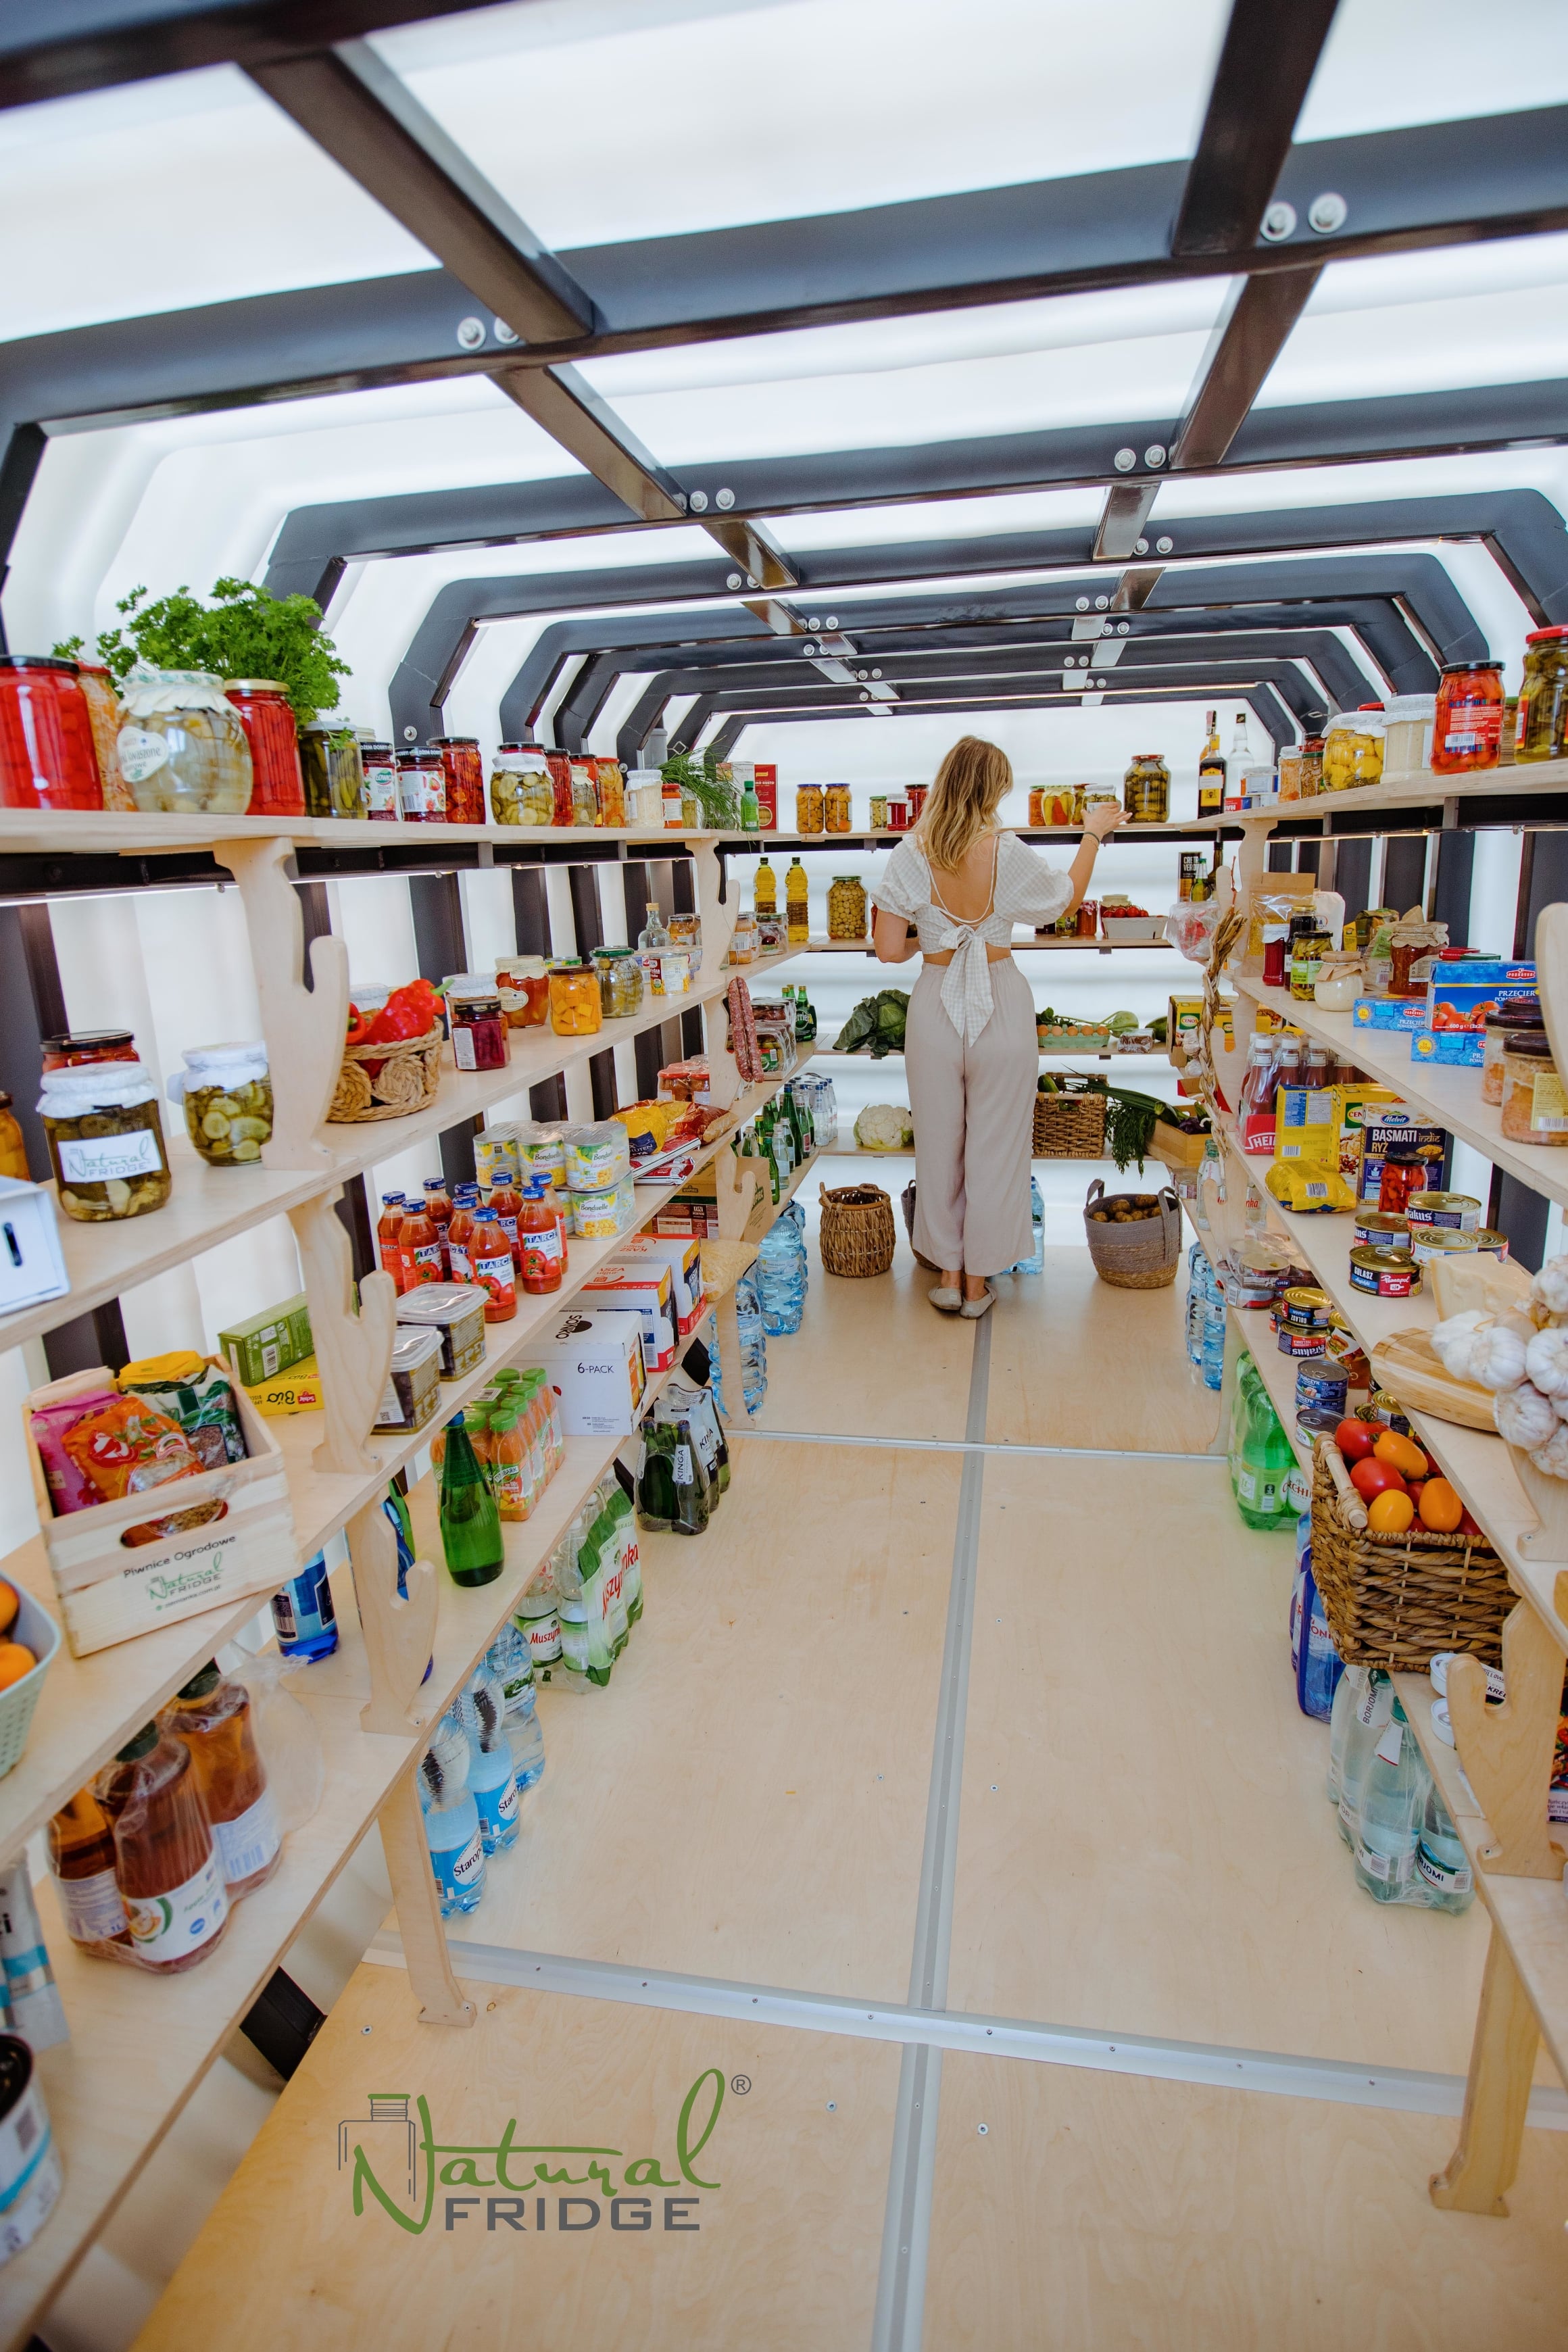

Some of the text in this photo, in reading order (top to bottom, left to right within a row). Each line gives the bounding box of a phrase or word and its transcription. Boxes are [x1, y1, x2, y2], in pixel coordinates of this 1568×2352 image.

[1498, 989, 1536, 998] PRZECIER
[1254, 1135, 1275, 1148] HEI
[1372, 1129, 1417, 1142] BASMATI
[1371, 1141, 1389, 1153] RYŻ
[69, 1136, 151, 1177] Natural
[89, 1163, 147, 1177] FRIDGE
[581, 1203, 608, 1212] Bonduelle
[1353, 1265, 1373, 1280] GULASZ
[555, 1314, 583, 1340] SONKO
[577, 1362, 615, 1374] 6-PACK
[266, 1390, 295, 1405] Bio
[123, 1536, 236, 1578] Piwnice Ogrodowe
[149, 1551, 224, 1600] Natural
[169, 1573, 222, 1596] FRIDGE
[1363, 1686, 1379, 1724] BORJOMI
